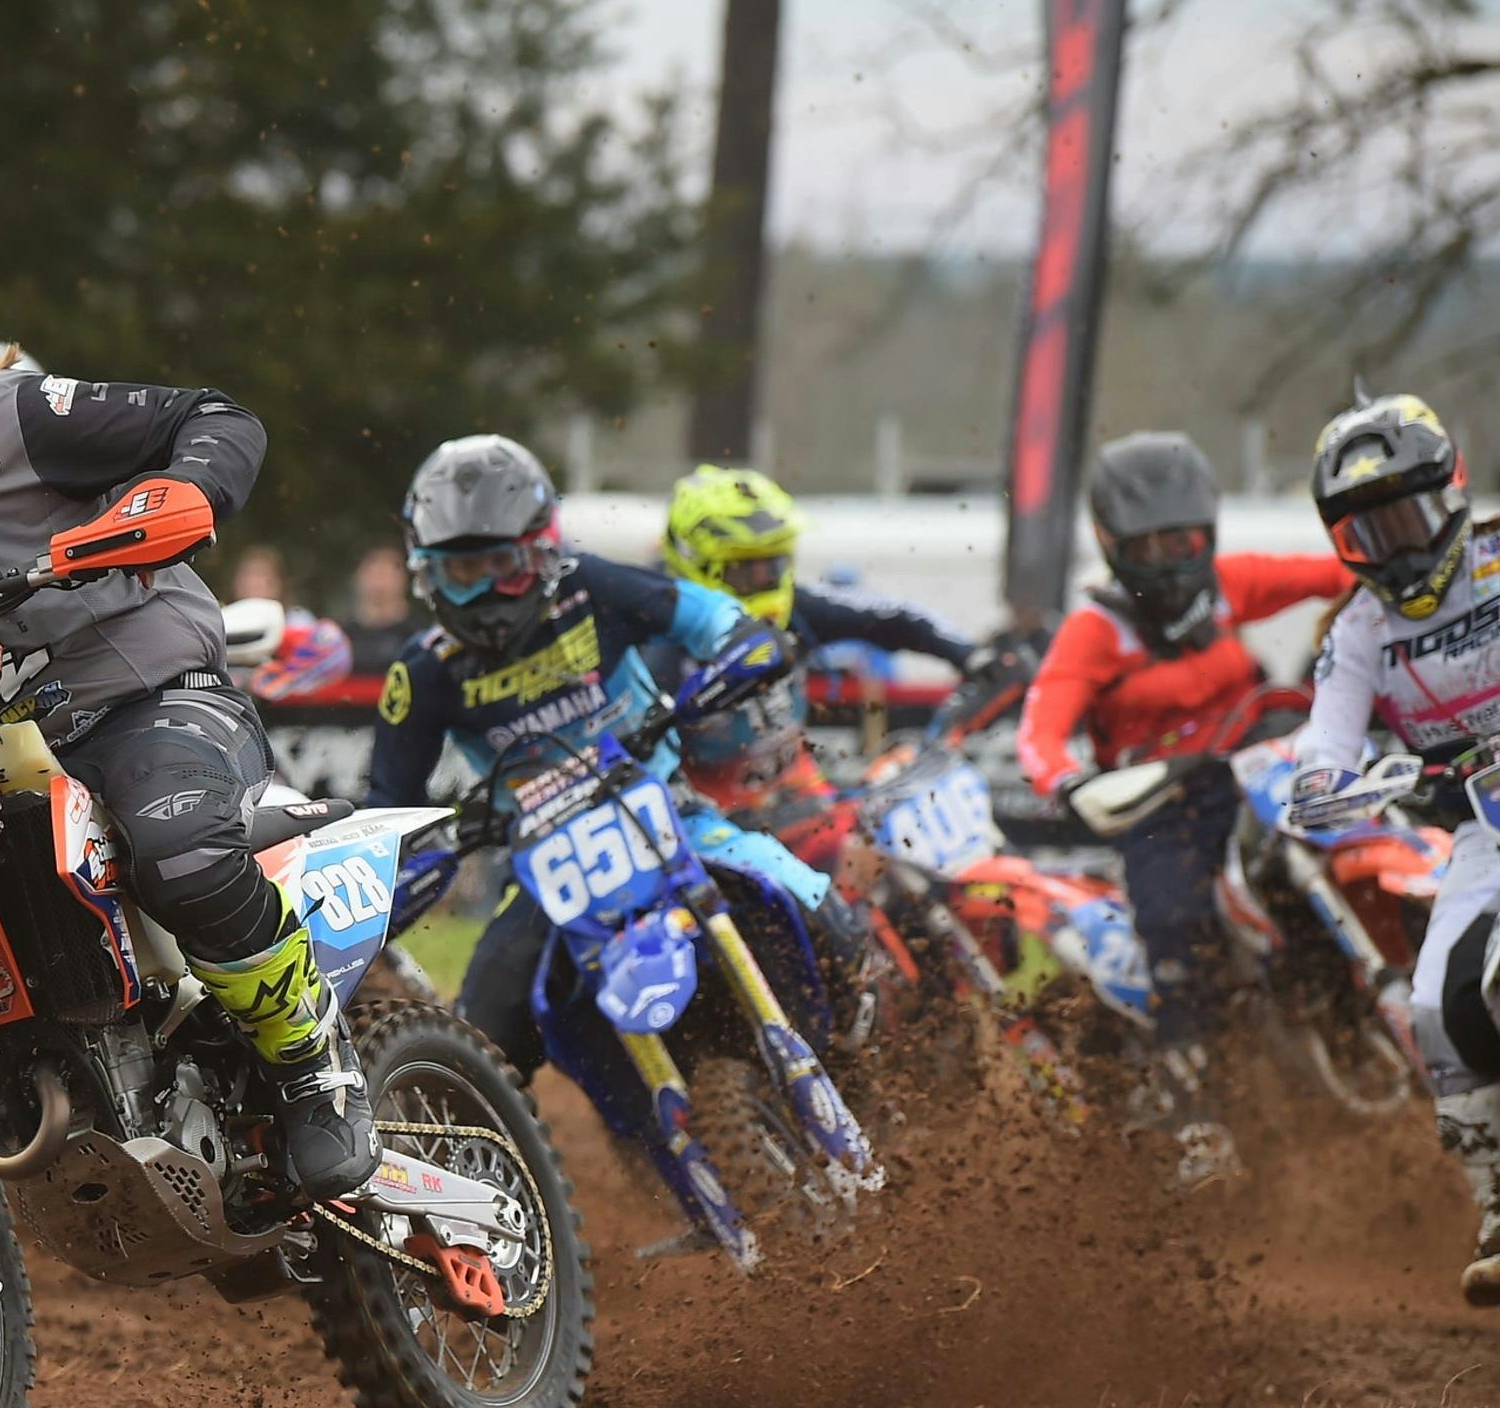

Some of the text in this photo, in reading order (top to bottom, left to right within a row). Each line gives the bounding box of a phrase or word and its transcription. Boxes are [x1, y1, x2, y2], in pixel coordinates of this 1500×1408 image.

[510, 682, 607, 735] YAMAHA
[530, 782, 679, 926] 650
[300, 854, 391, 933] 828
[421, 1173, 443, 1193] RK
